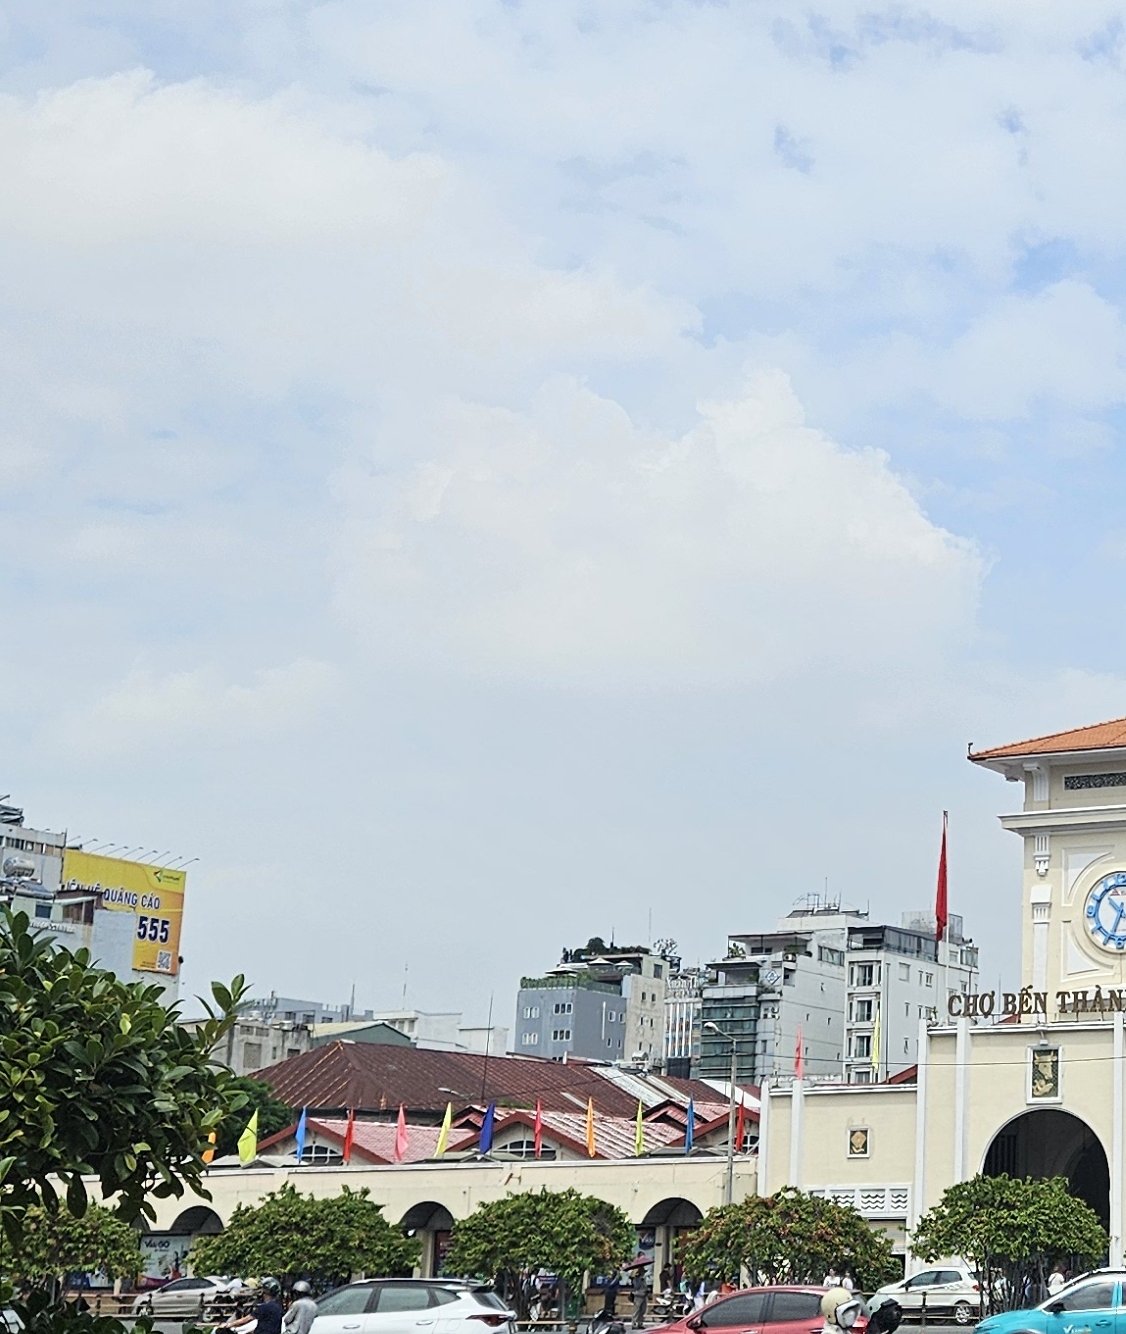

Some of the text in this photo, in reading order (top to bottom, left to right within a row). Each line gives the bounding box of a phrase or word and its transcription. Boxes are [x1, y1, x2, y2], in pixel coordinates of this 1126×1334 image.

[103, 888, 138, 906] QUẢNG
[141, 893, 160, 910] CÁO
[137, 915, 170, 943] 555
[948, 990, 995, 1018] CHỢ
[1002, 985, 1047, 1015] BẾN
